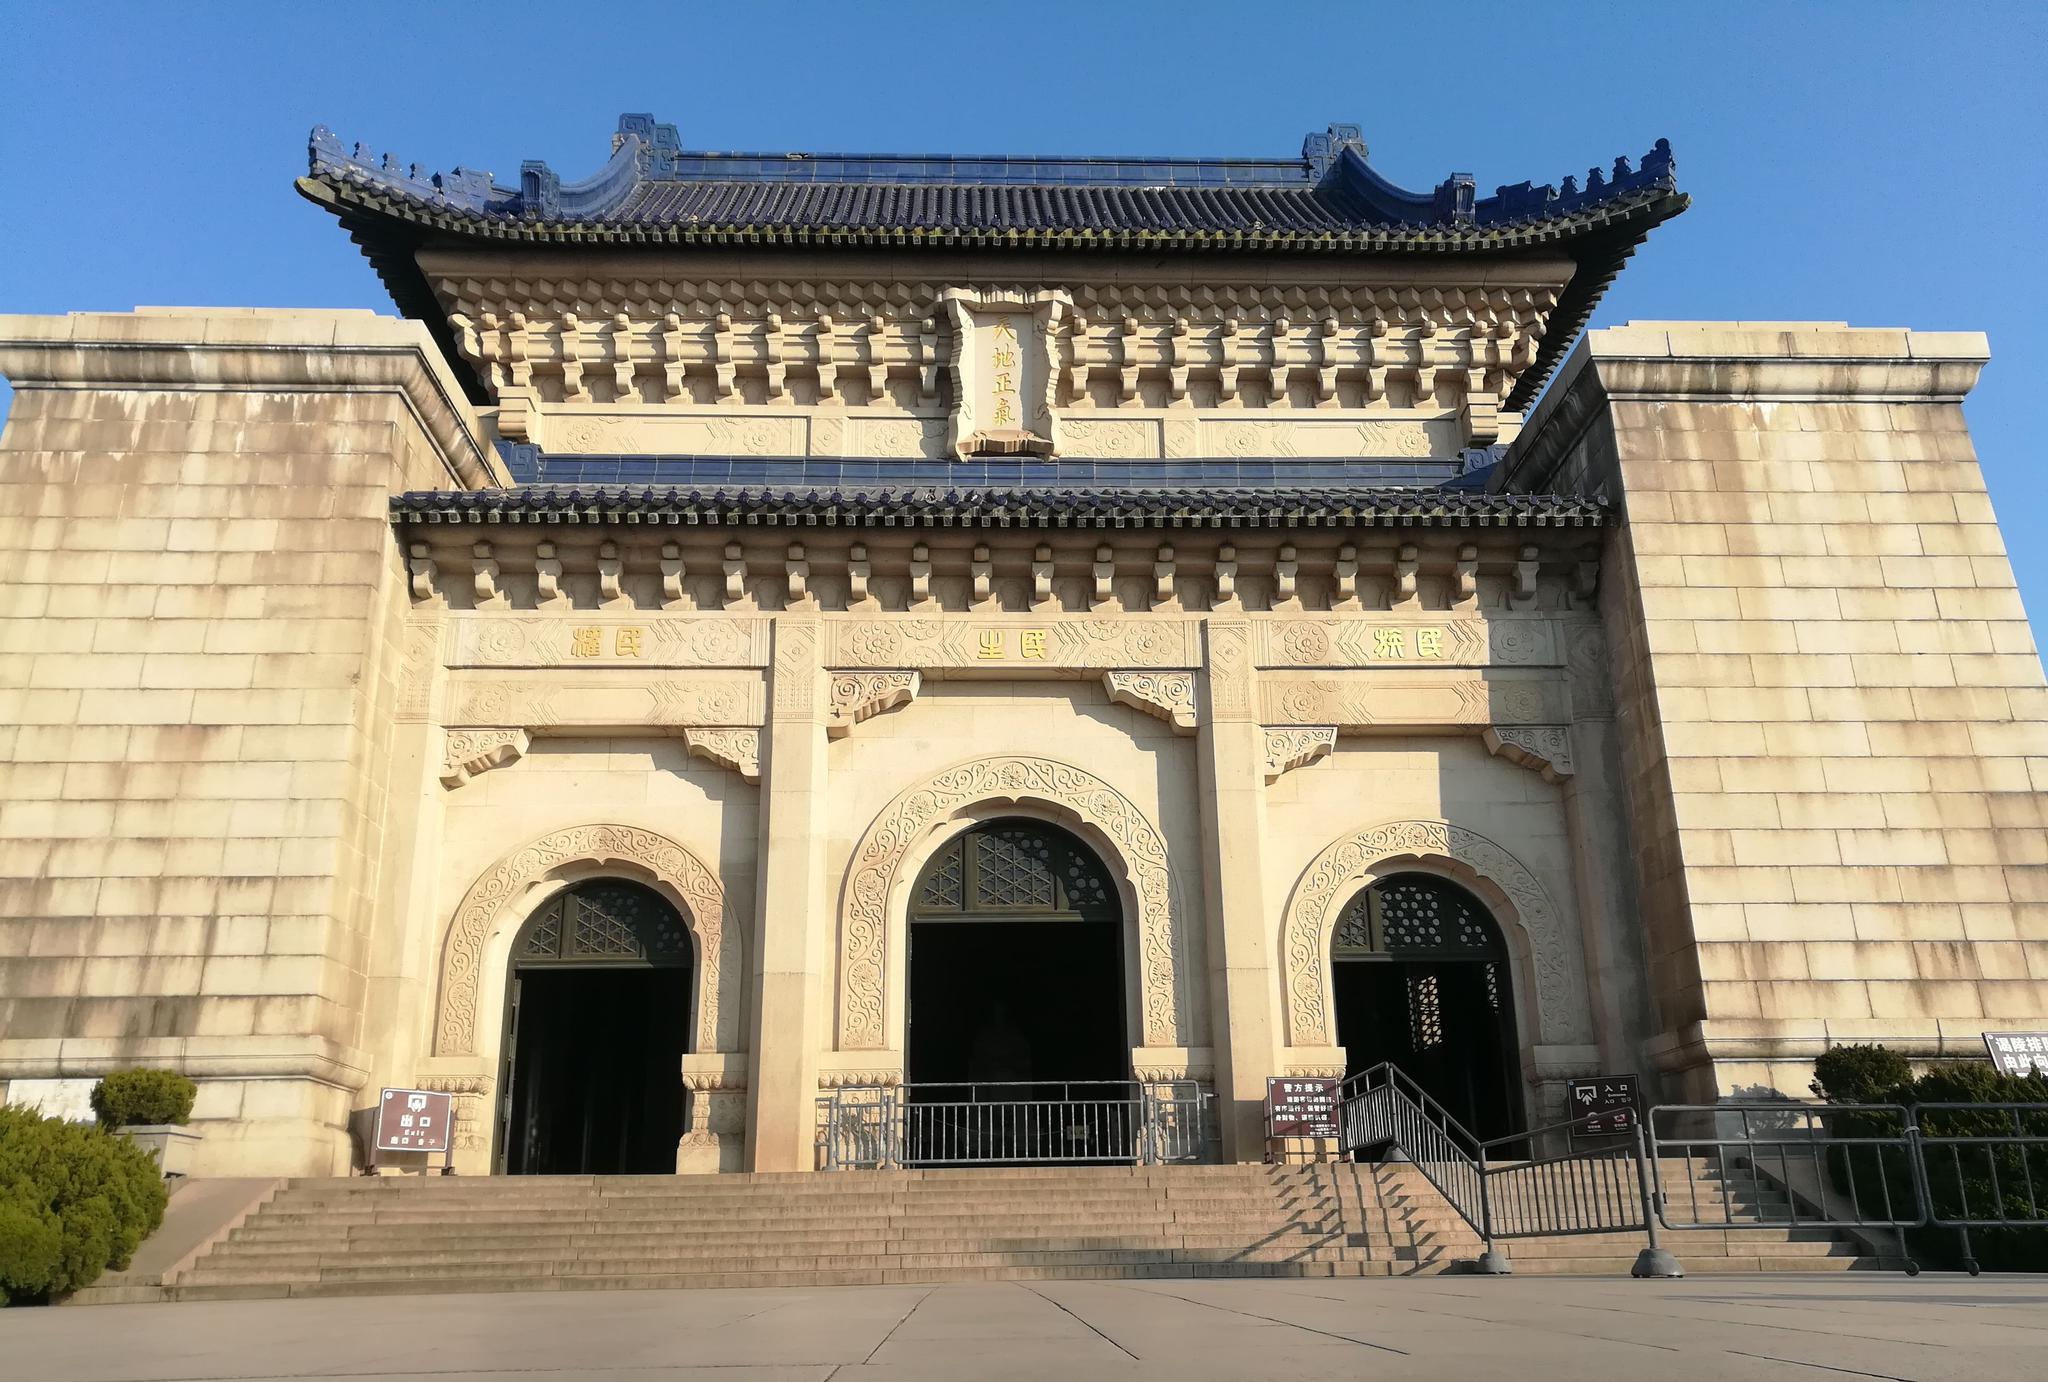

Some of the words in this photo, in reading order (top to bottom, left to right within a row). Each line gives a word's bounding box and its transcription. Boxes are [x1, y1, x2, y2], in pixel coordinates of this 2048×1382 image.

[992, 314, 1016, 426] 天地正氣
[1283, 1083, 1324, 1093] 警方提示
[1604, 1084, 1628, 1092] 入口
[400, 1114, 432, 1128] 出口
[405, 1128, 425, 1137] Exit
